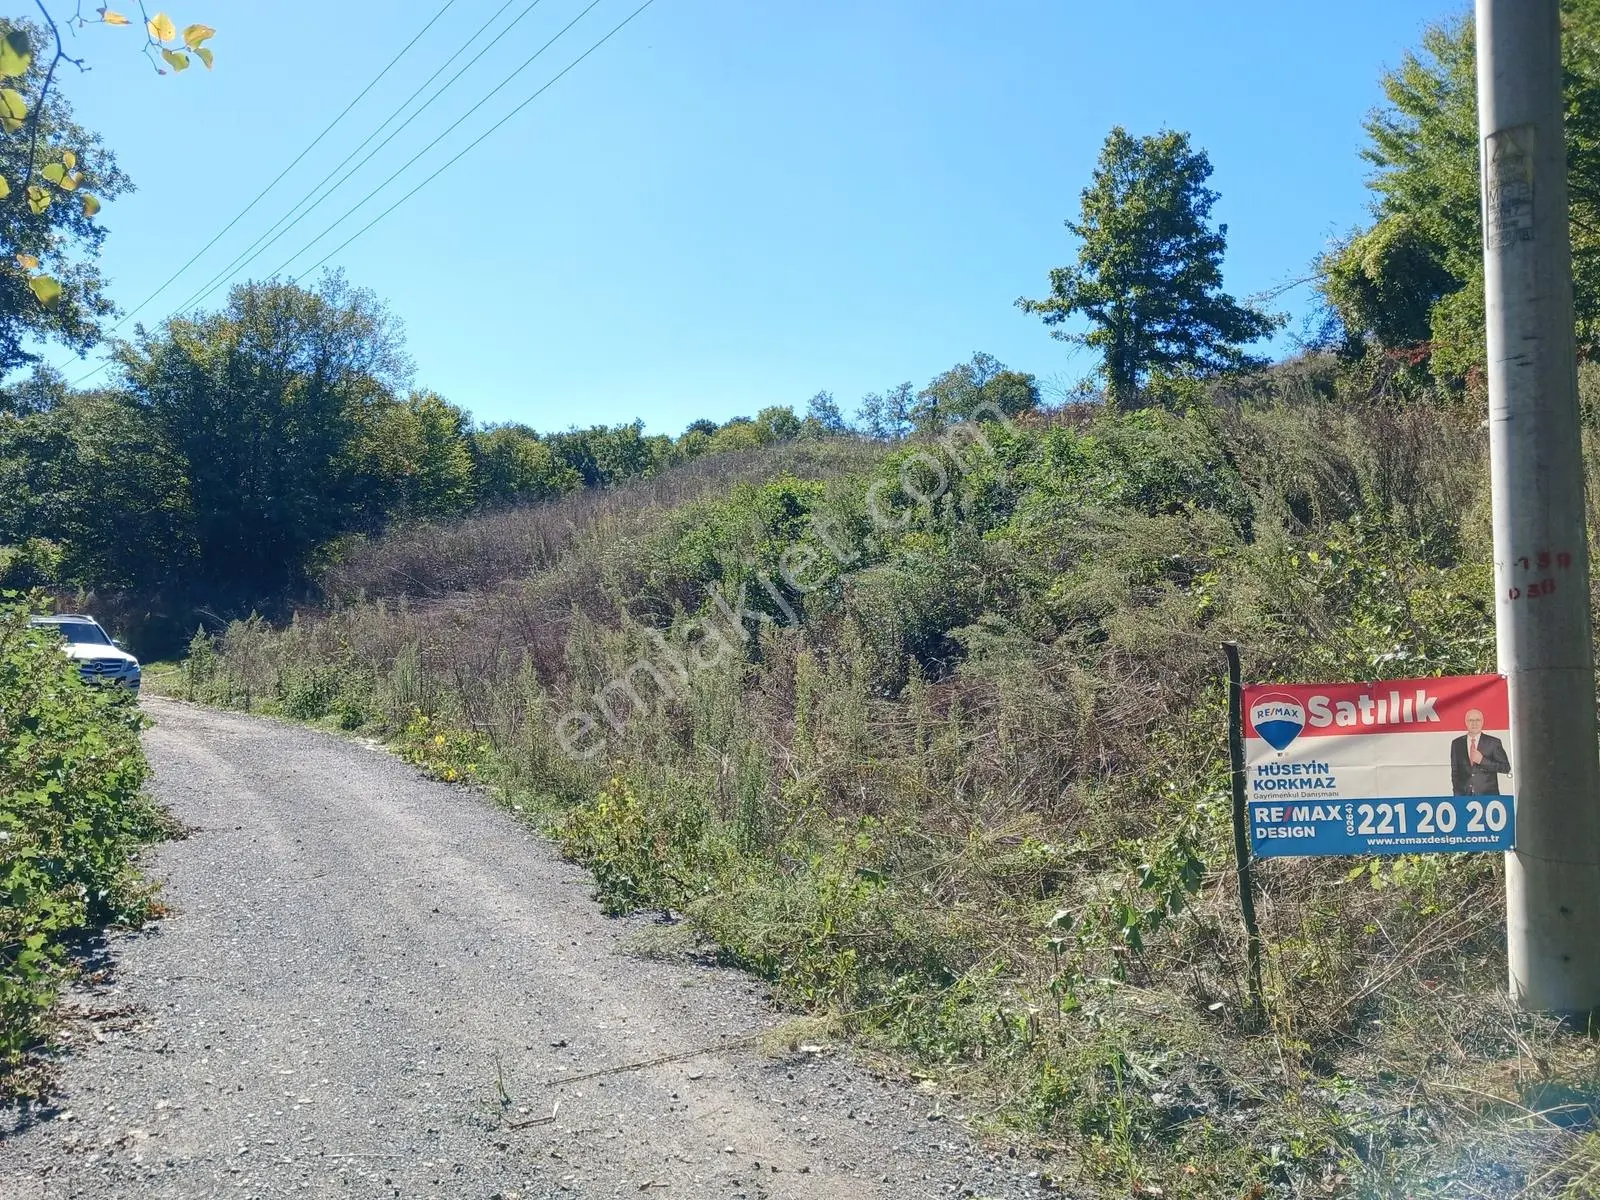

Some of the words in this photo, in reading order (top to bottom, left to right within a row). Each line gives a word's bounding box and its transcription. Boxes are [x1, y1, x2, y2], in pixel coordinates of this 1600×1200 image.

[1257, 708, 1299, 719] RE/MAX
[1307, 690, 1440, 727] Satılık
[1257, 760, 1329, 776] HÜSEYİN
[1253, 777, 1336, 791] KORKMAZ
[1253, 792, 1299, 800] Gayrimenkul
[1254, 805, 1343, 823] RE/MAX
[1345, 803, 1355, 837] (0264)
[1357, 803, 1407, 834] 221
[1416, 802, 1456, 833] 20
[1466, 800, 1507, 832] 20
[1256, 826, 1316, 839] DESIGN
[1367, 835, 1500, 846] www.remaxdesign.com.tr
